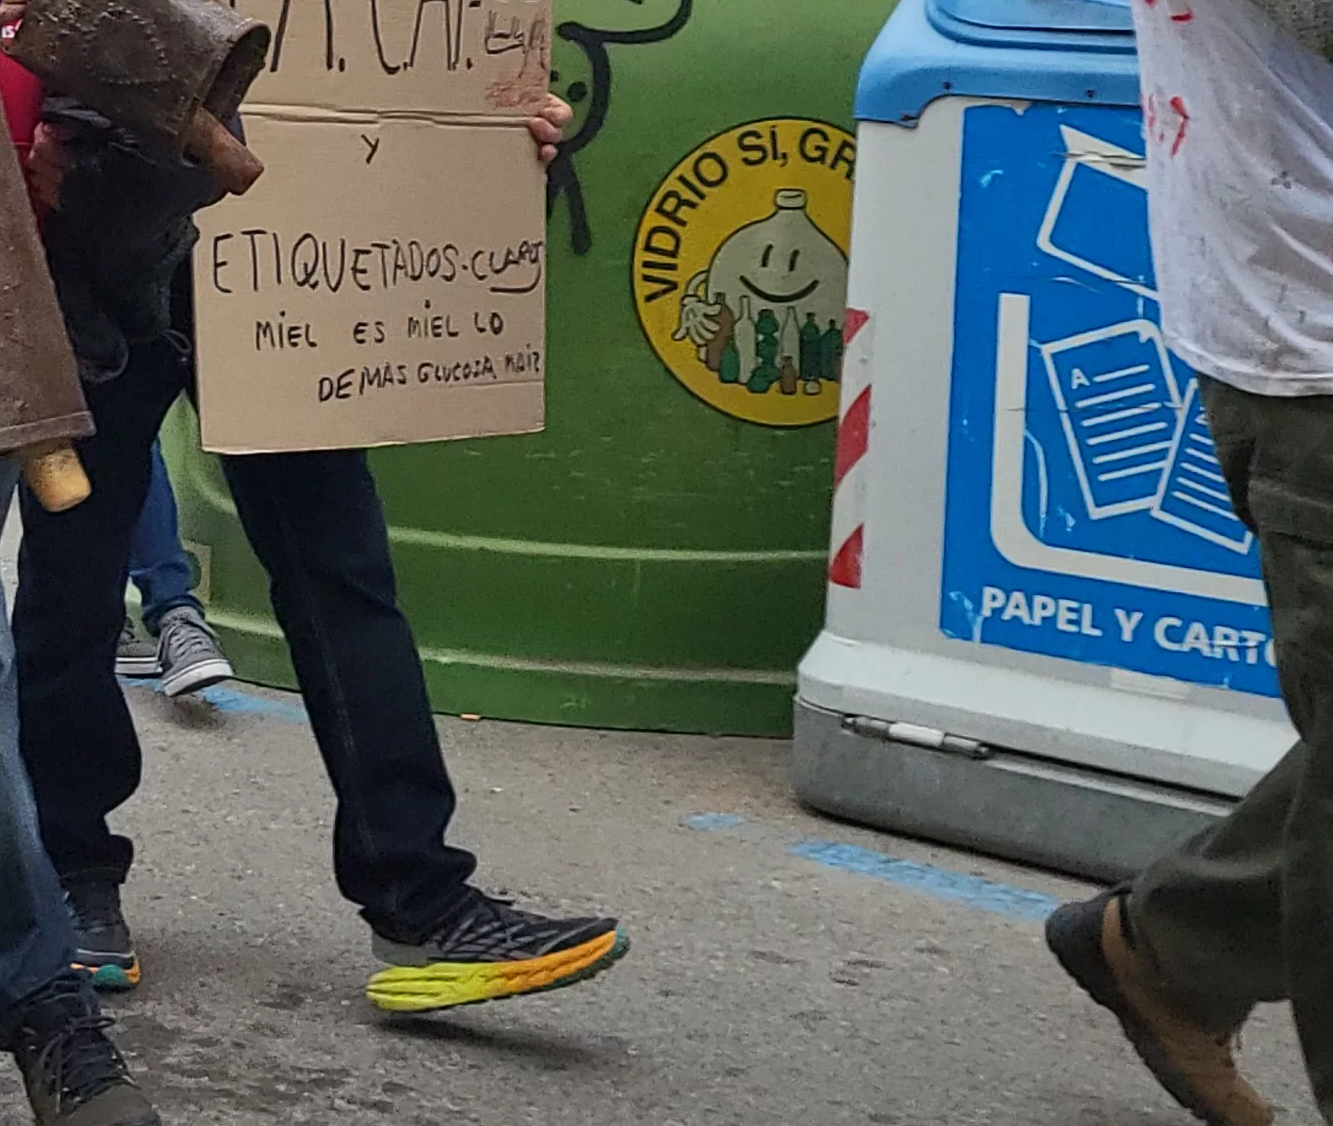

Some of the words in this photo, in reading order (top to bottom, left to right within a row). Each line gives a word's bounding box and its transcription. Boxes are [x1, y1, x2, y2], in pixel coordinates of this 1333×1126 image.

[643, 150, 729, 304] VIDRIO
[353, 319, 385, 345] ES
[474, 310, 504, 336] LO
[981, 586, 1103, 638] PAPEL
[1114, 608, 1145, 643] Y
